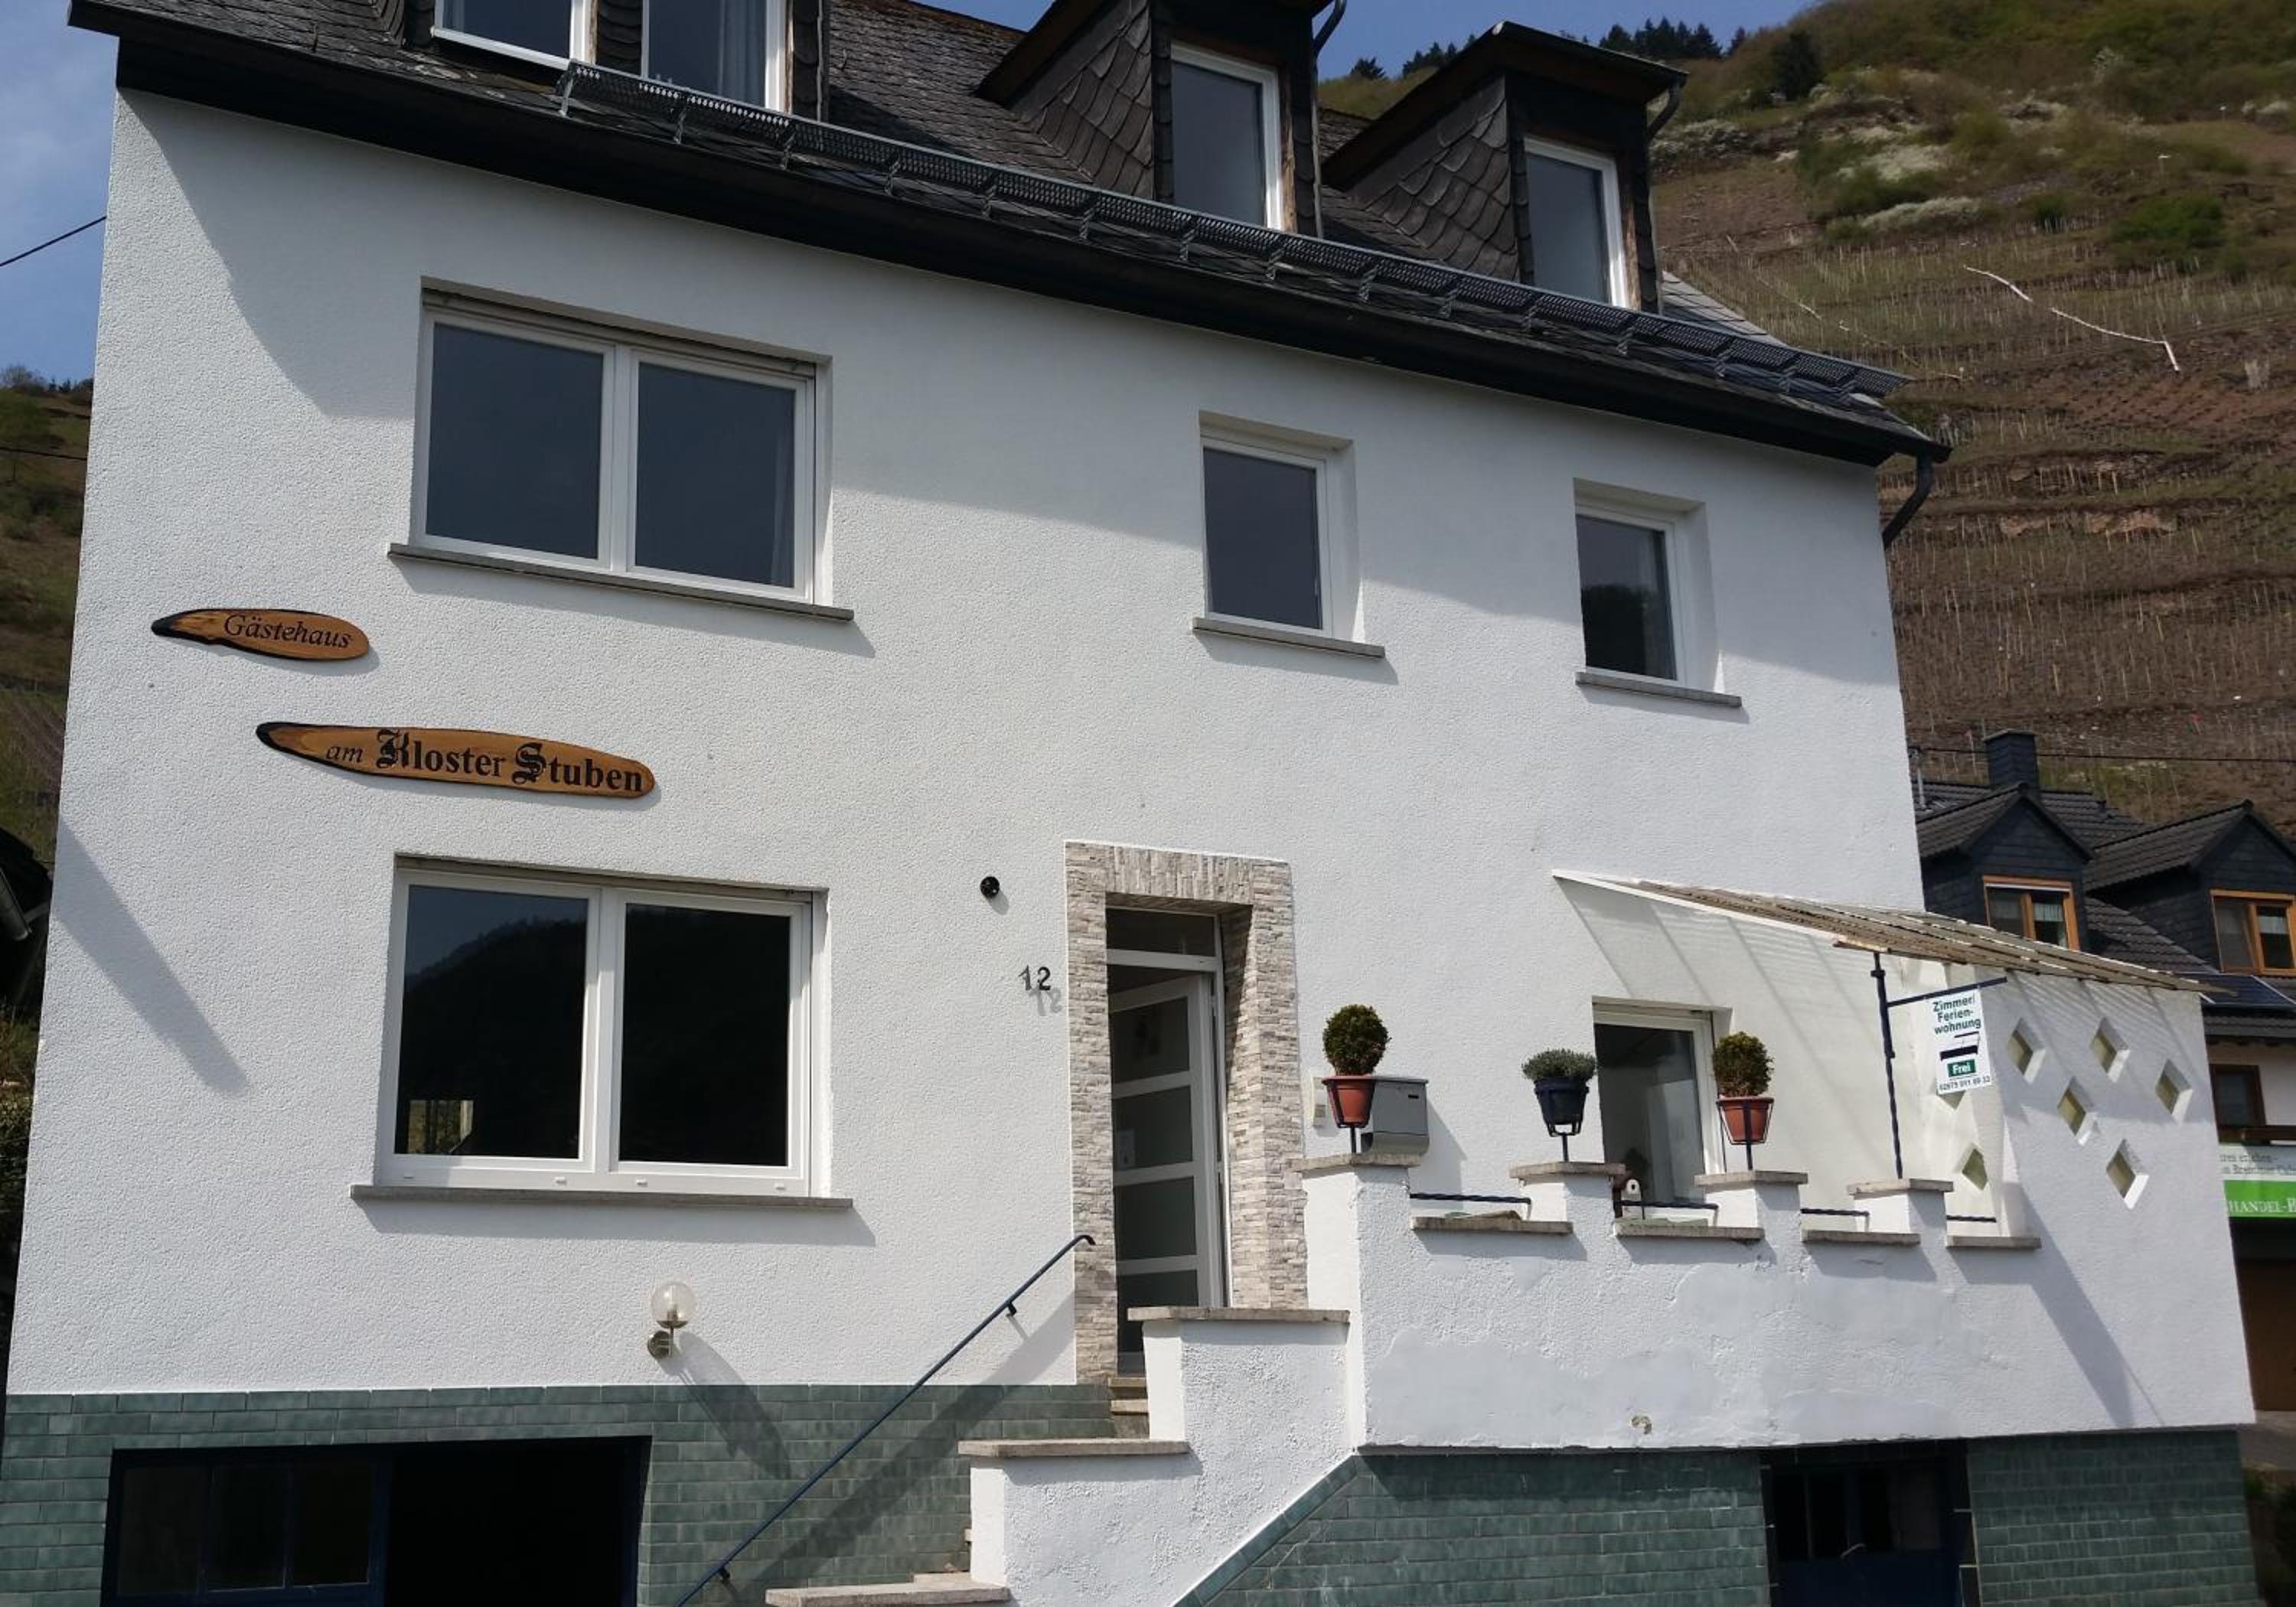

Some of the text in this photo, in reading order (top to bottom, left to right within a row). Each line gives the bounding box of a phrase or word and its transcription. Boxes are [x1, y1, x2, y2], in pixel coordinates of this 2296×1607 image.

[223, 613, 354, 650] Gästehaus
[325, 728, 644, 793] am Kloster Stuben
[1018, 964, 1052, 991] 12
[1934, 1018, 1981, 1035] wohnung
[1937, 1009, 1974, 1023] Ferien-
[1952, 1061, 1971, 1075] Frei
